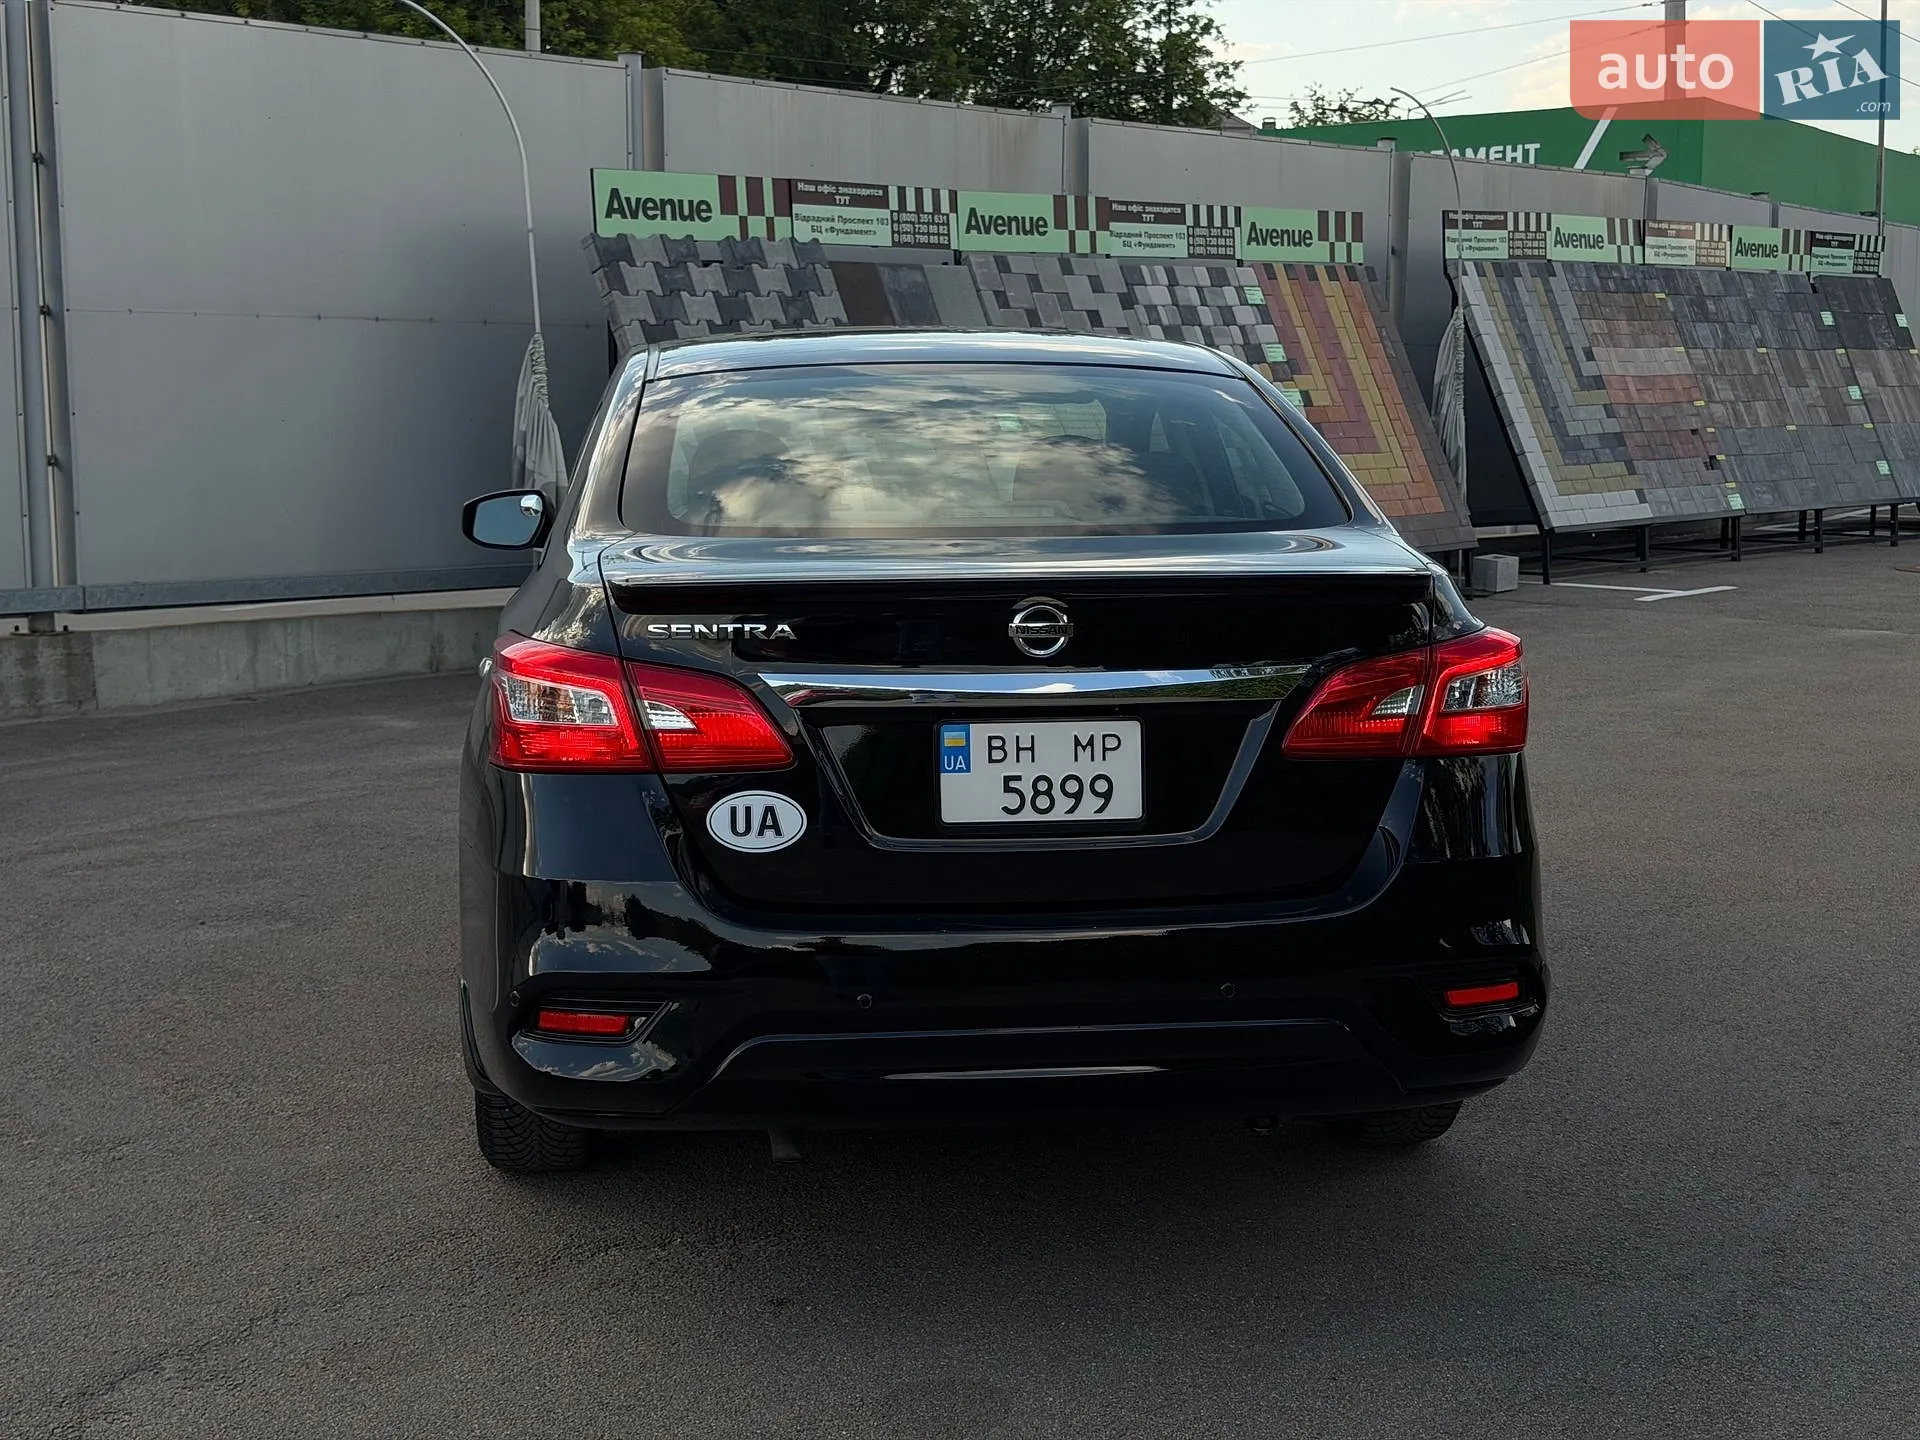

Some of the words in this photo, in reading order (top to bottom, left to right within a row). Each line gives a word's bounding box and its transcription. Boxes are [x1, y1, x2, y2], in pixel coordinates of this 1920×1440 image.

[1431, 143, 1541, 165] МЕНТ
[797, 182, 816, 192] Наш
[817, 183, 837, 194] офіс
[605, 187, 713, 223] Avenue
[834, 195, 850, 205] ТУТ
[810, 225, 823, 235] БЦ
[837, 216, 874, 226] Проспект
[934, 215, 947, 223] 631
[965, 207, 1048, 236] Avenue
[1246, 222, 1313, 248] Avenue
[1553, 226, 1605, 251] Avenue
[1735, 237, 1778, 260] Avenue
[647, 623, 798, 641] SENTRA
[1015, 625, 1068, 635] NISSAN
[987, 735, 1035, 763] BH
[1074, 733, 1122, 762] MP
[944, 755, 967, 771] UA
[1000, 774, 1114, 816] 5899
[729, 805, 783, 838] UA
